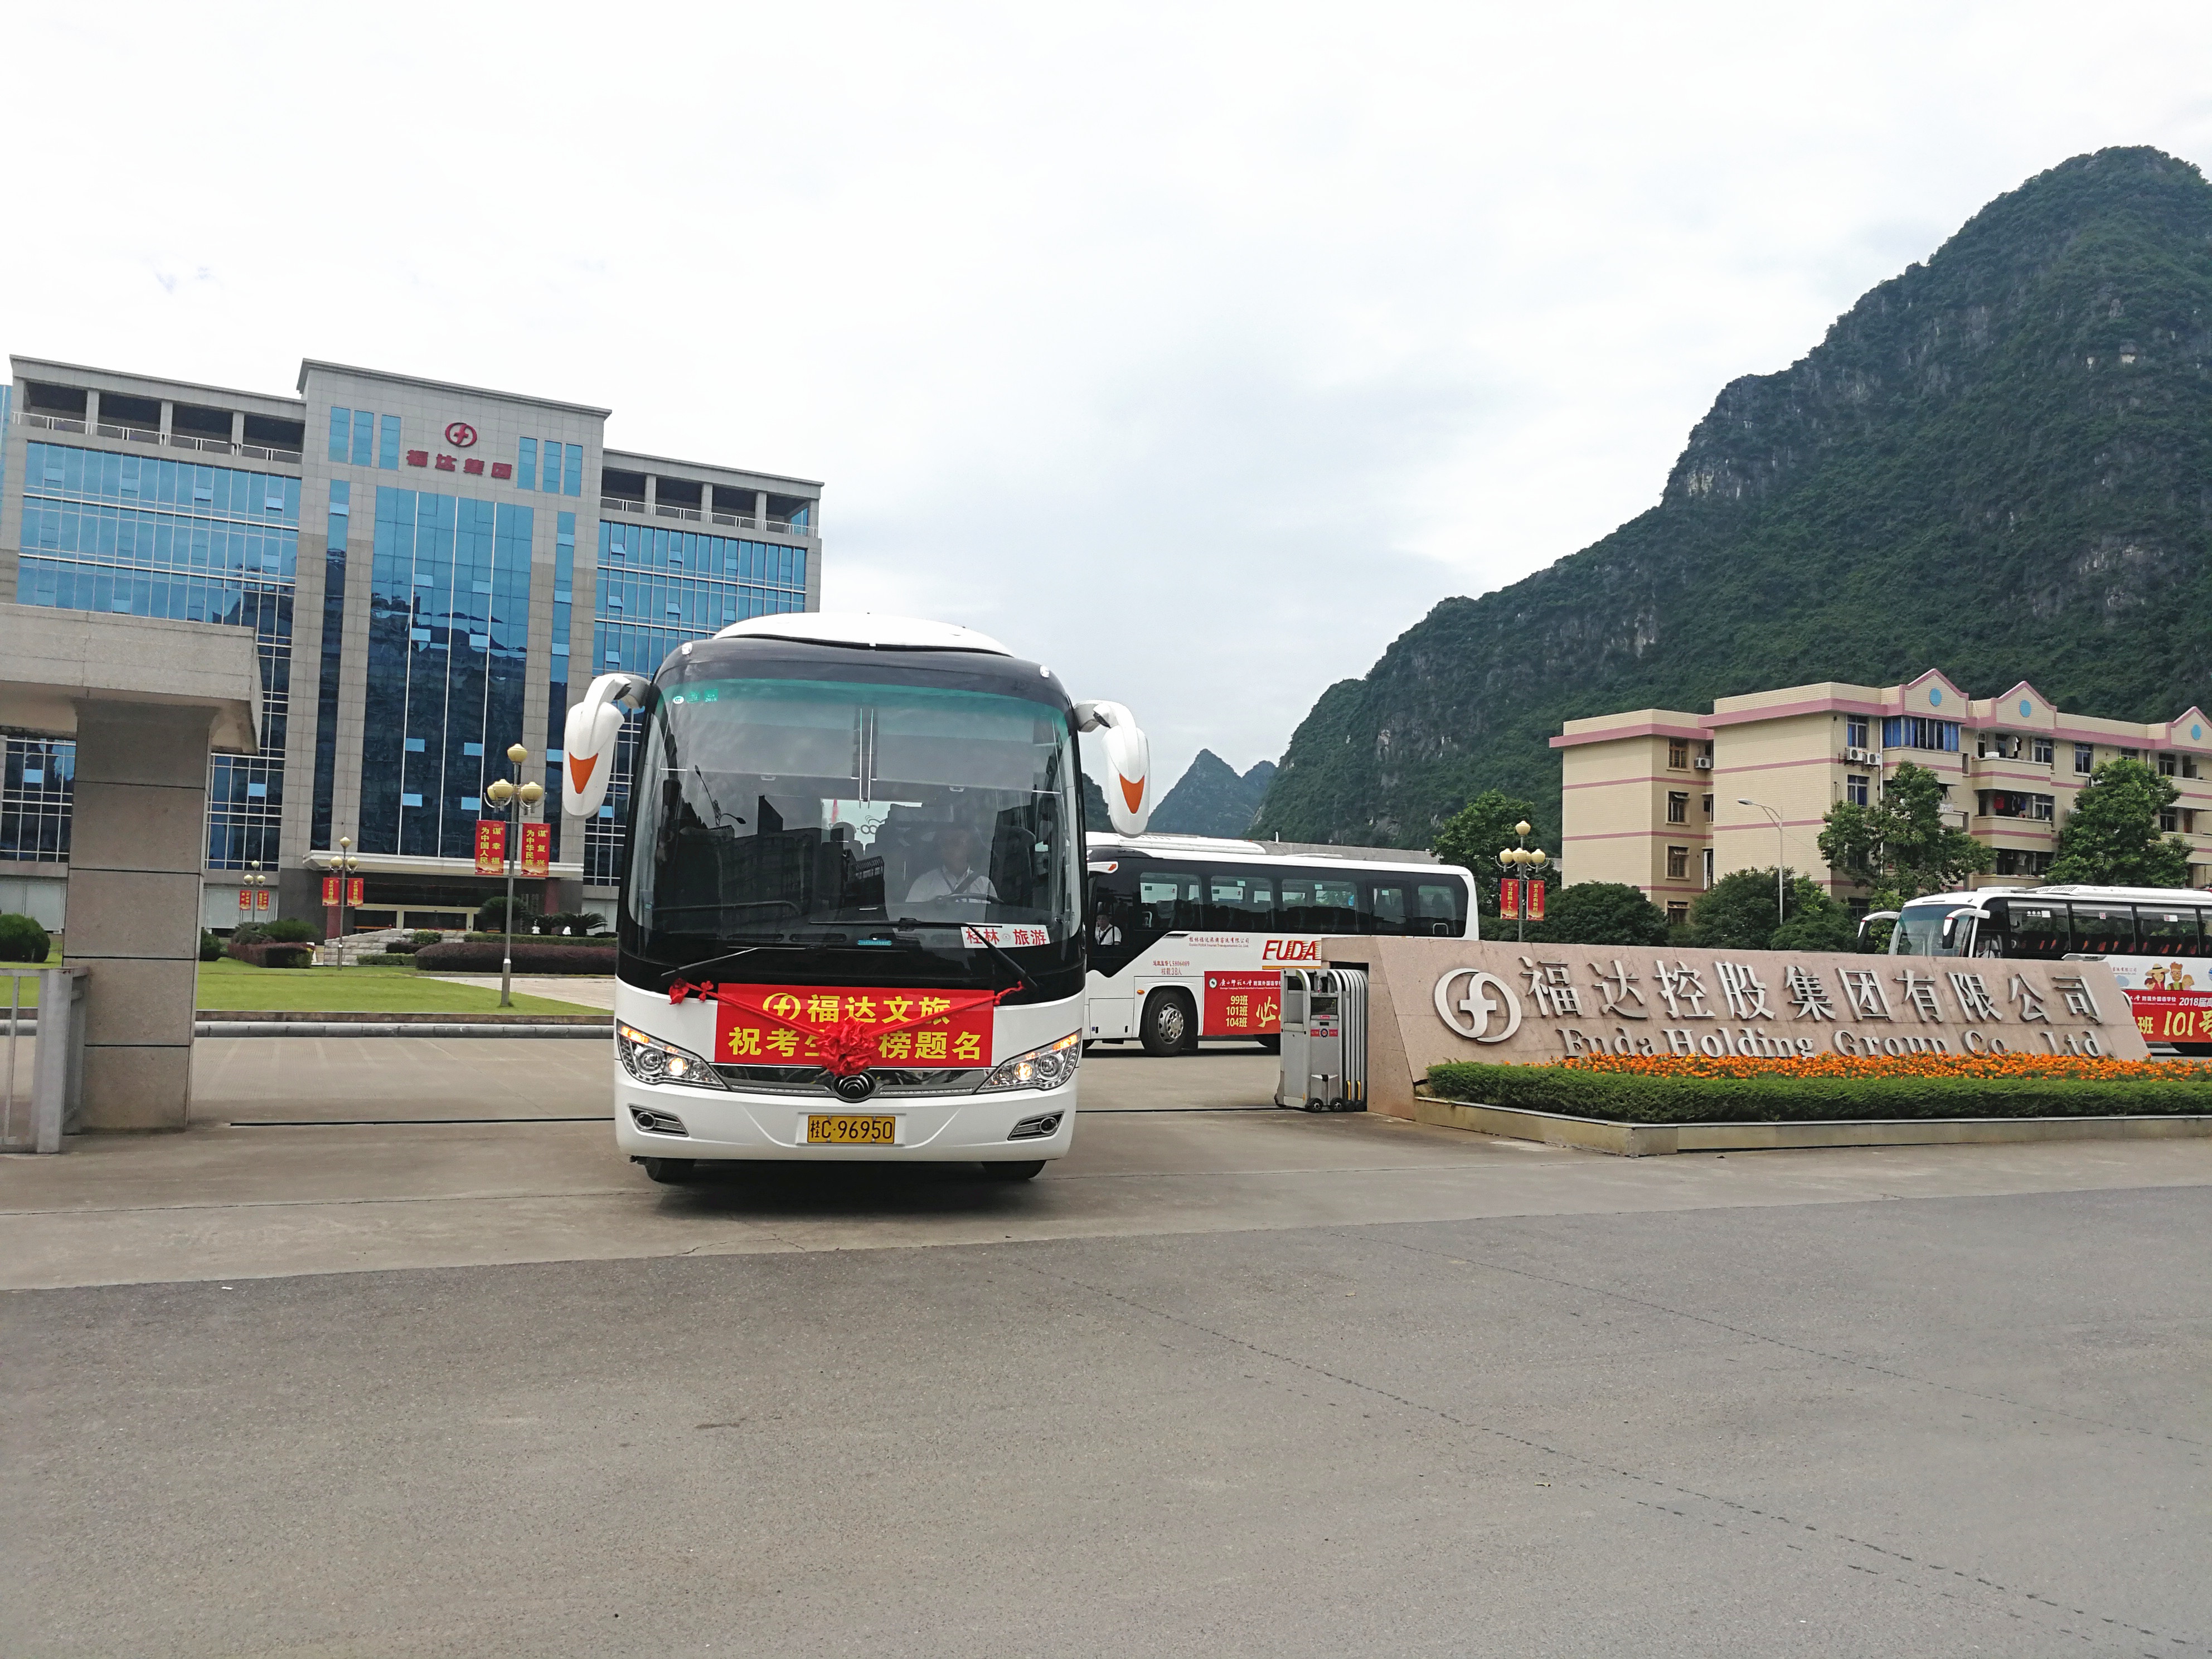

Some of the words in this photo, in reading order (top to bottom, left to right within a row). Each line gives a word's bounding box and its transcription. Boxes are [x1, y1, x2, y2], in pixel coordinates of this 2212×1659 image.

[480, 827, 489, 864] 为中国人民
[491, 827, 501, 865] 谋幸福
[525, 830, 535, 866] 为中华民族
[536, 830, 546, 866] 谋复兴
[966, 927, 1000, 945] 桂林
[1012, 929, 1046, 945] 旅游
[1262, 939, 1321, 961] FUDA
[1230, 995, 1248, 1005] 99班
[1518, 944, 2103, 1025] 福达控股集团有限公司
[807, 995, 951, 1025] 福达文旅
[1226, 1006, 1248, 1016] 101班
[1226, 1017, 1247, 1027] 104班
[1256, 996, 1281, 1027] 必
[2133, 1016, 2154, 1034] 班
[728, 1027, 982, 1060] 祝考榜题名
[1557, 1027, 1655, 1058] Fuda
[1661, 1027, 1815, 1059] Holding
